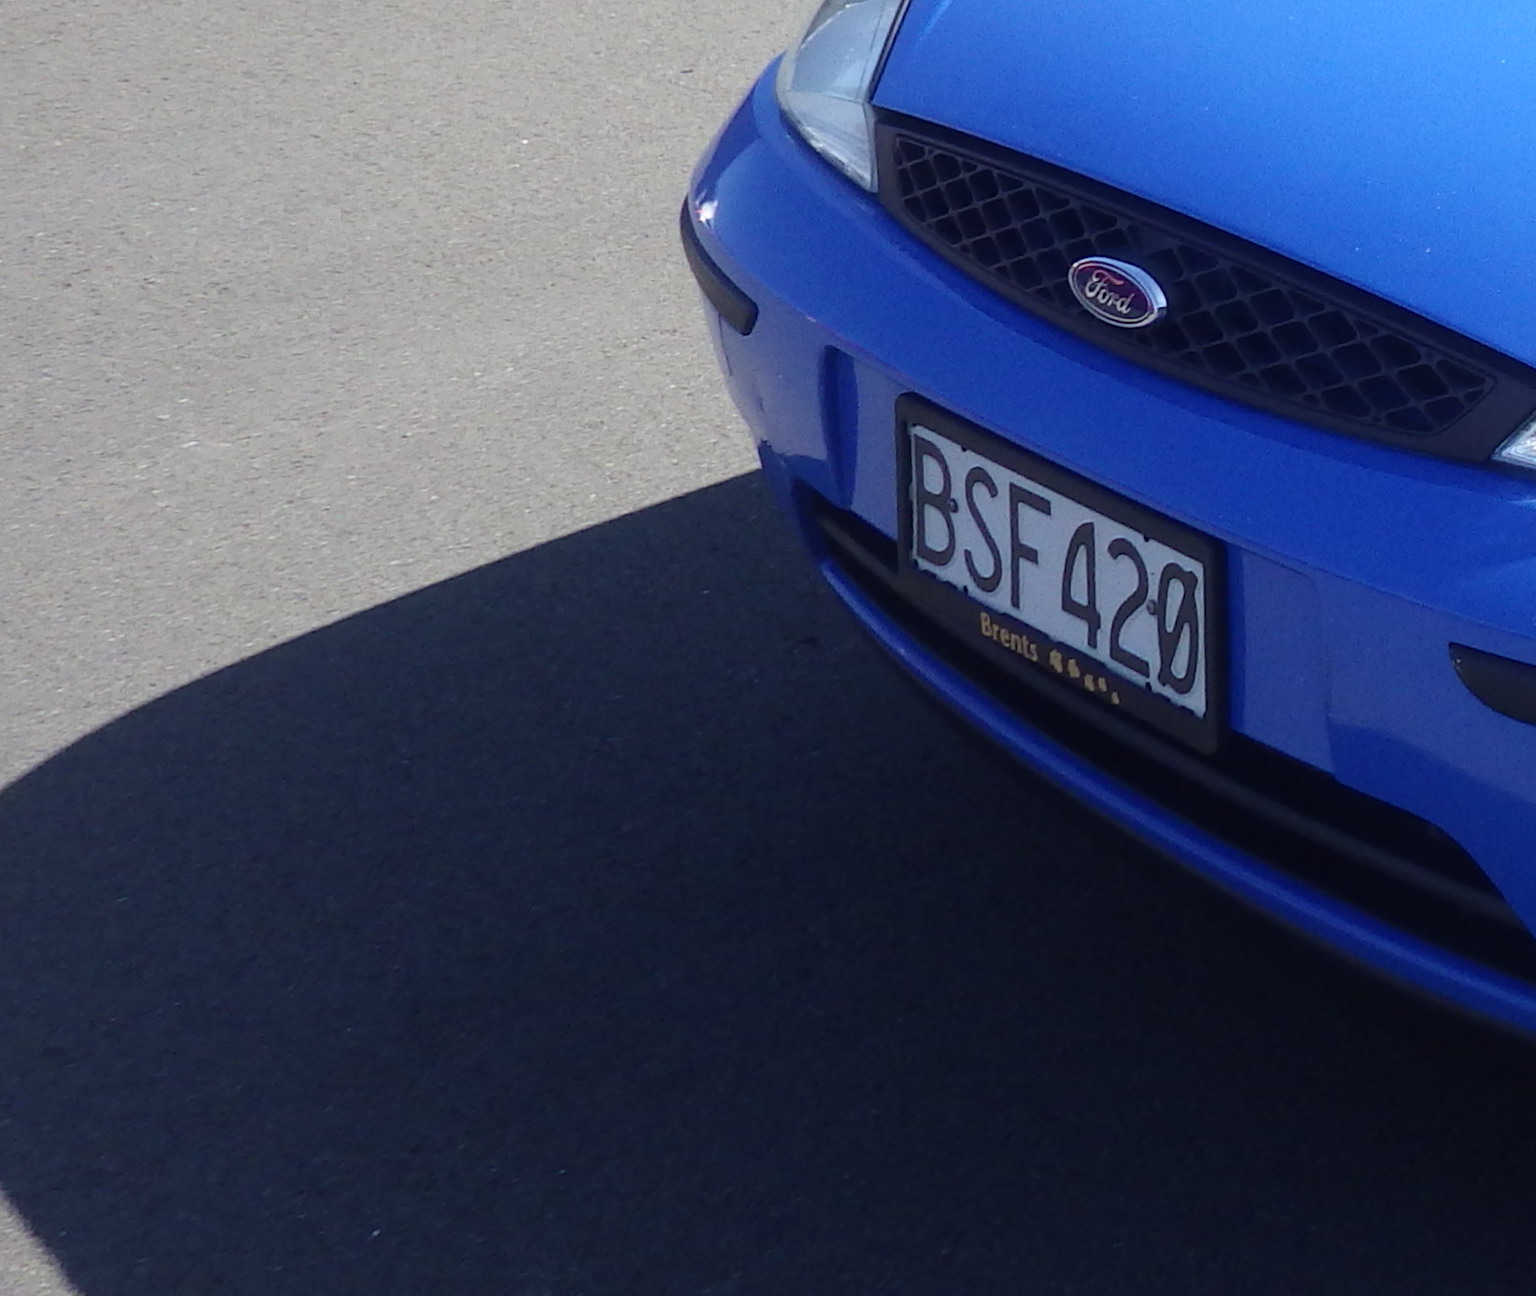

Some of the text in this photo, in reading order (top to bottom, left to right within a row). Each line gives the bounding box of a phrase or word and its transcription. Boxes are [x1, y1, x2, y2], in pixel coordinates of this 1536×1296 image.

[1085, 270, 1135, 314] Ford
[914, 433, 1199, 695] BSF420
[979, 612, 1038, 661] Brents
